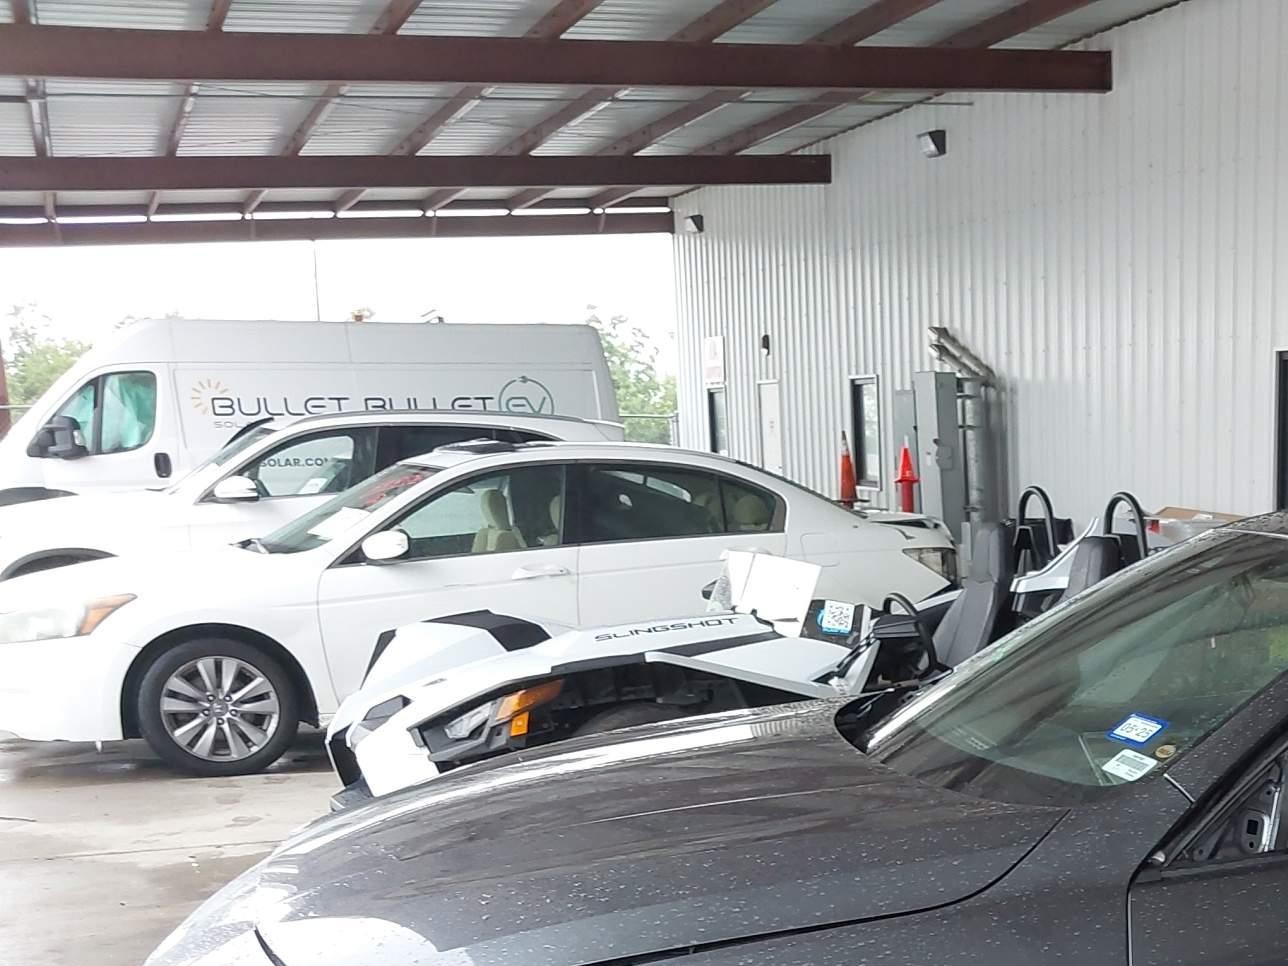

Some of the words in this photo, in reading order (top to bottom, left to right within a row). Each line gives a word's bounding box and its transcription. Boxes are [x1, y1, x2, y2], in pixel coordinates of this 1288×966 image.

[211, 397, 350, 416] BULLET
[506, 396, 546, 414] EV
[594, 617, 739, 642] SLINGSHOT
